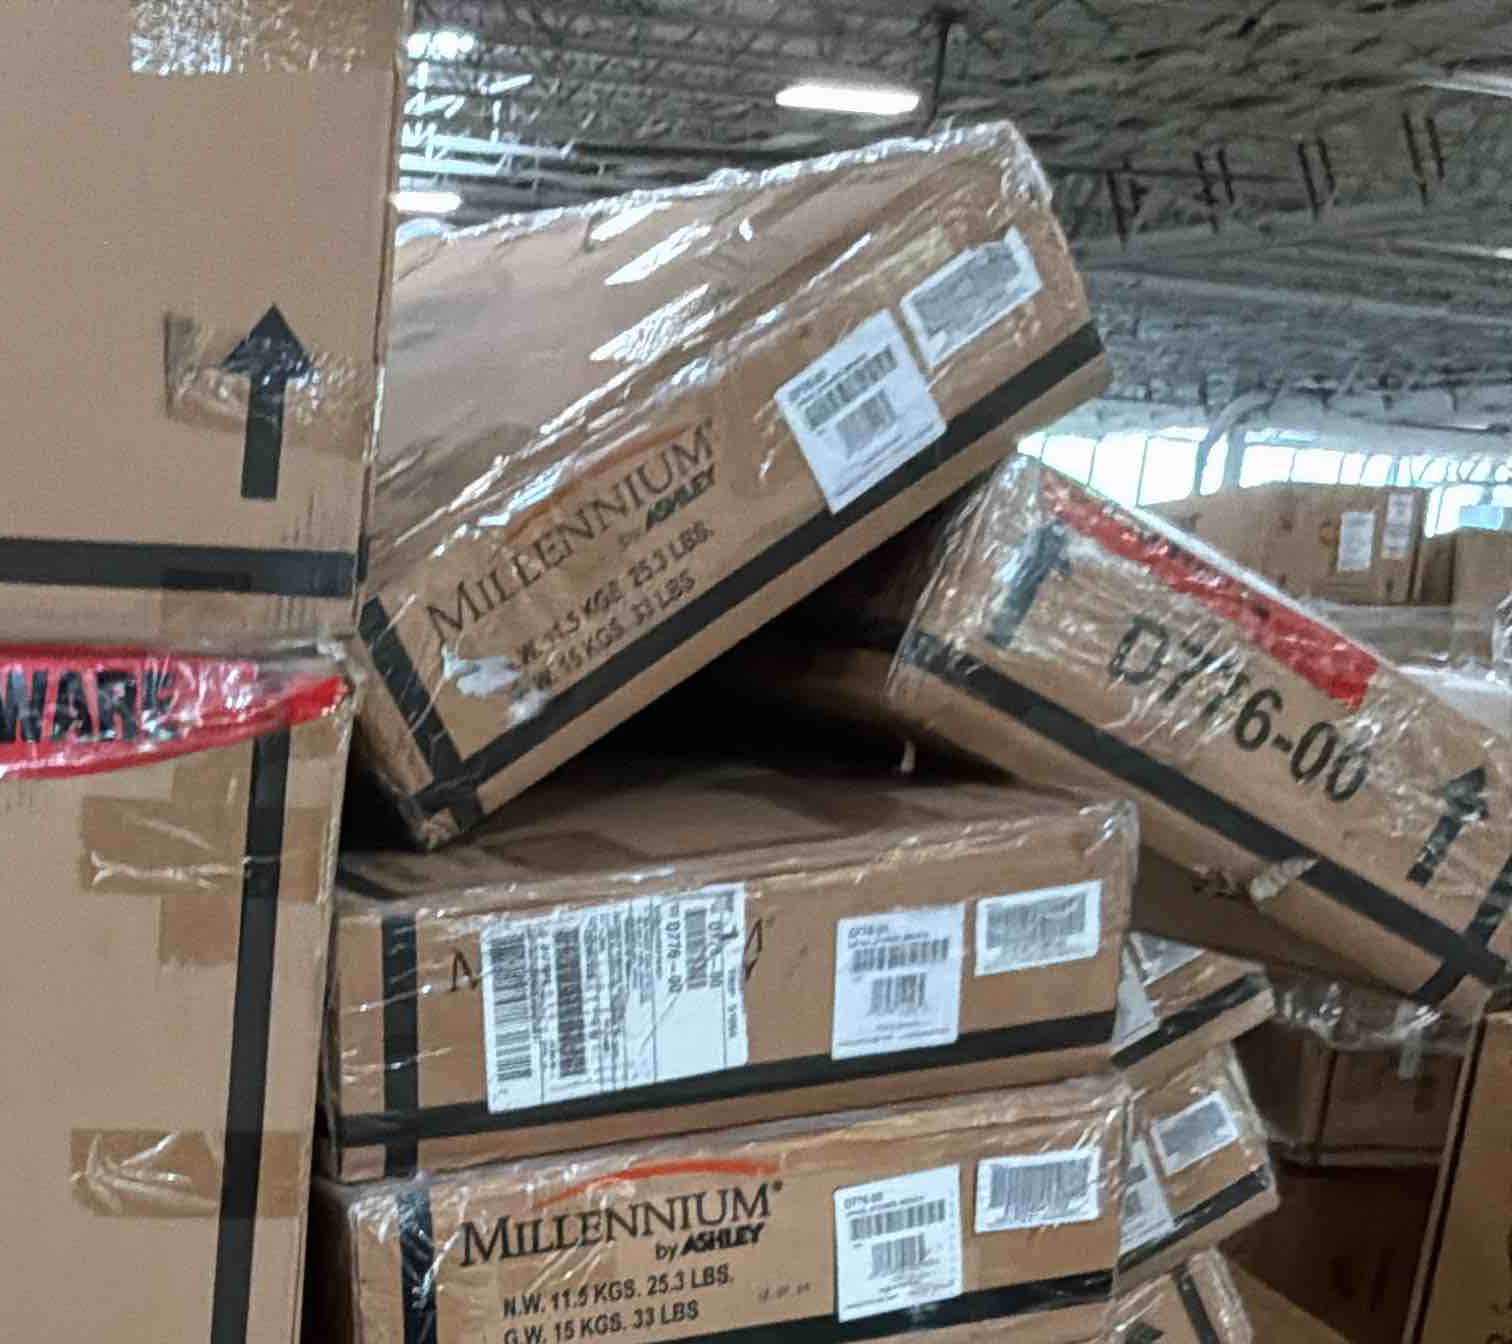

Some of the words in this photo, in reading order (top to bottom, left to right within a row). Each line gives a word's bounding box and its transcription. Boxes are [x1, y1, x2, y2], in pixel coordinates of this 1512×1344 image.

[460, 1182, 772, 1266] MILLENNIUM
[654, 1241, 680, 1263] by
[680, 1221, 766, 1256] ASHLEY
[554, 1320, 576, 1344] 15
[632, 1308, 656, 1330] 33
[658, 1299, 700, 1326] LBS
